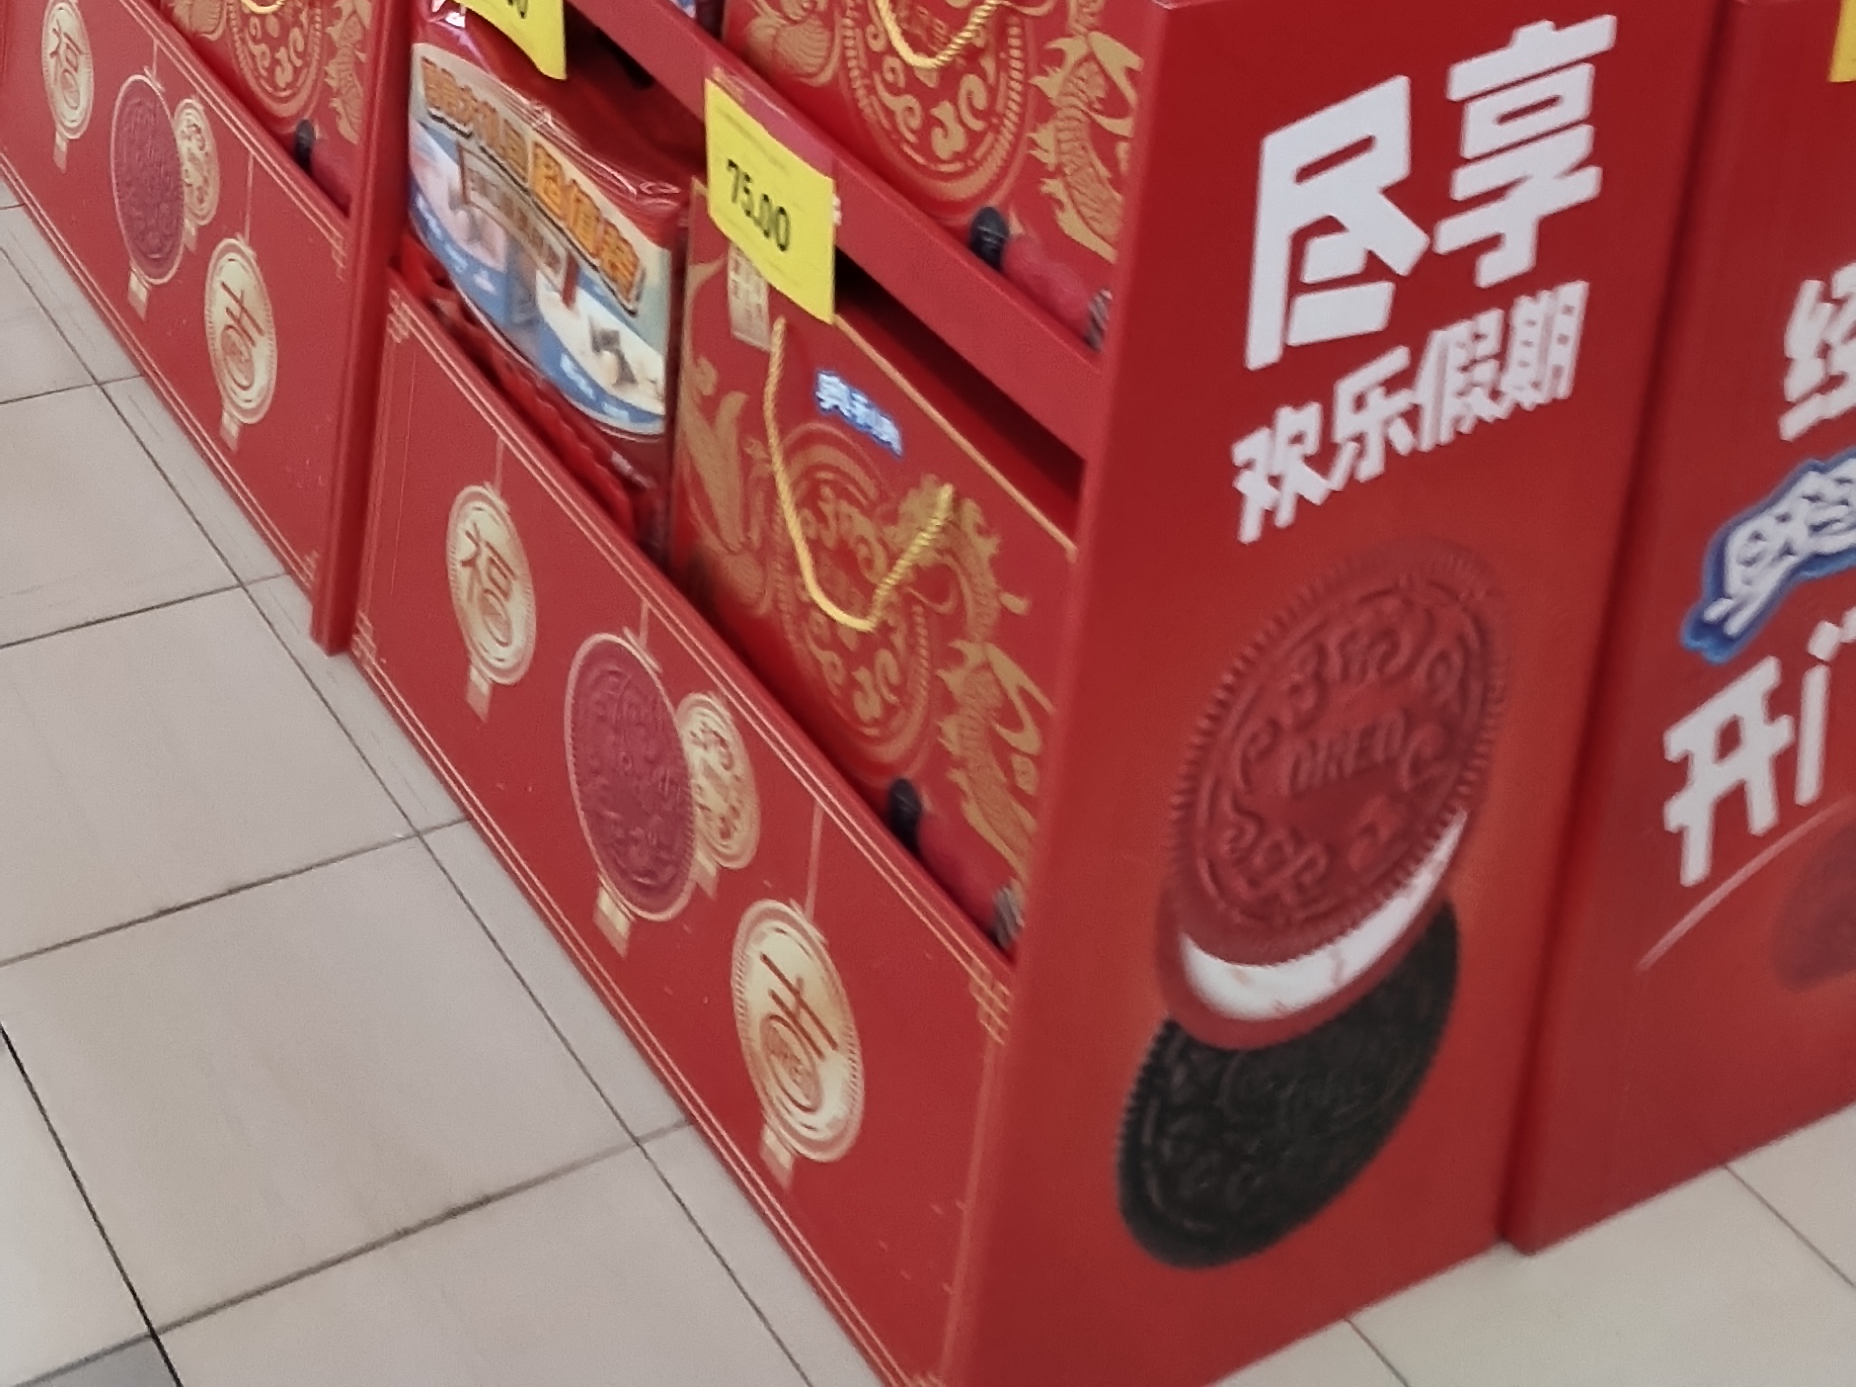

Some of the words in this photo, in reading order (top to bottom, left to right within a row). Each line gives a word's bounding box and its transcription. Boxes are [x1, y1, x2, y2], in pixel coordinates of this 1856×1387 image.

[727, 158, 791, 253] 75.00
[1246, 14, 1619, 372] 尽享
[1232, 280, 1590, 543] 欢乐假期
